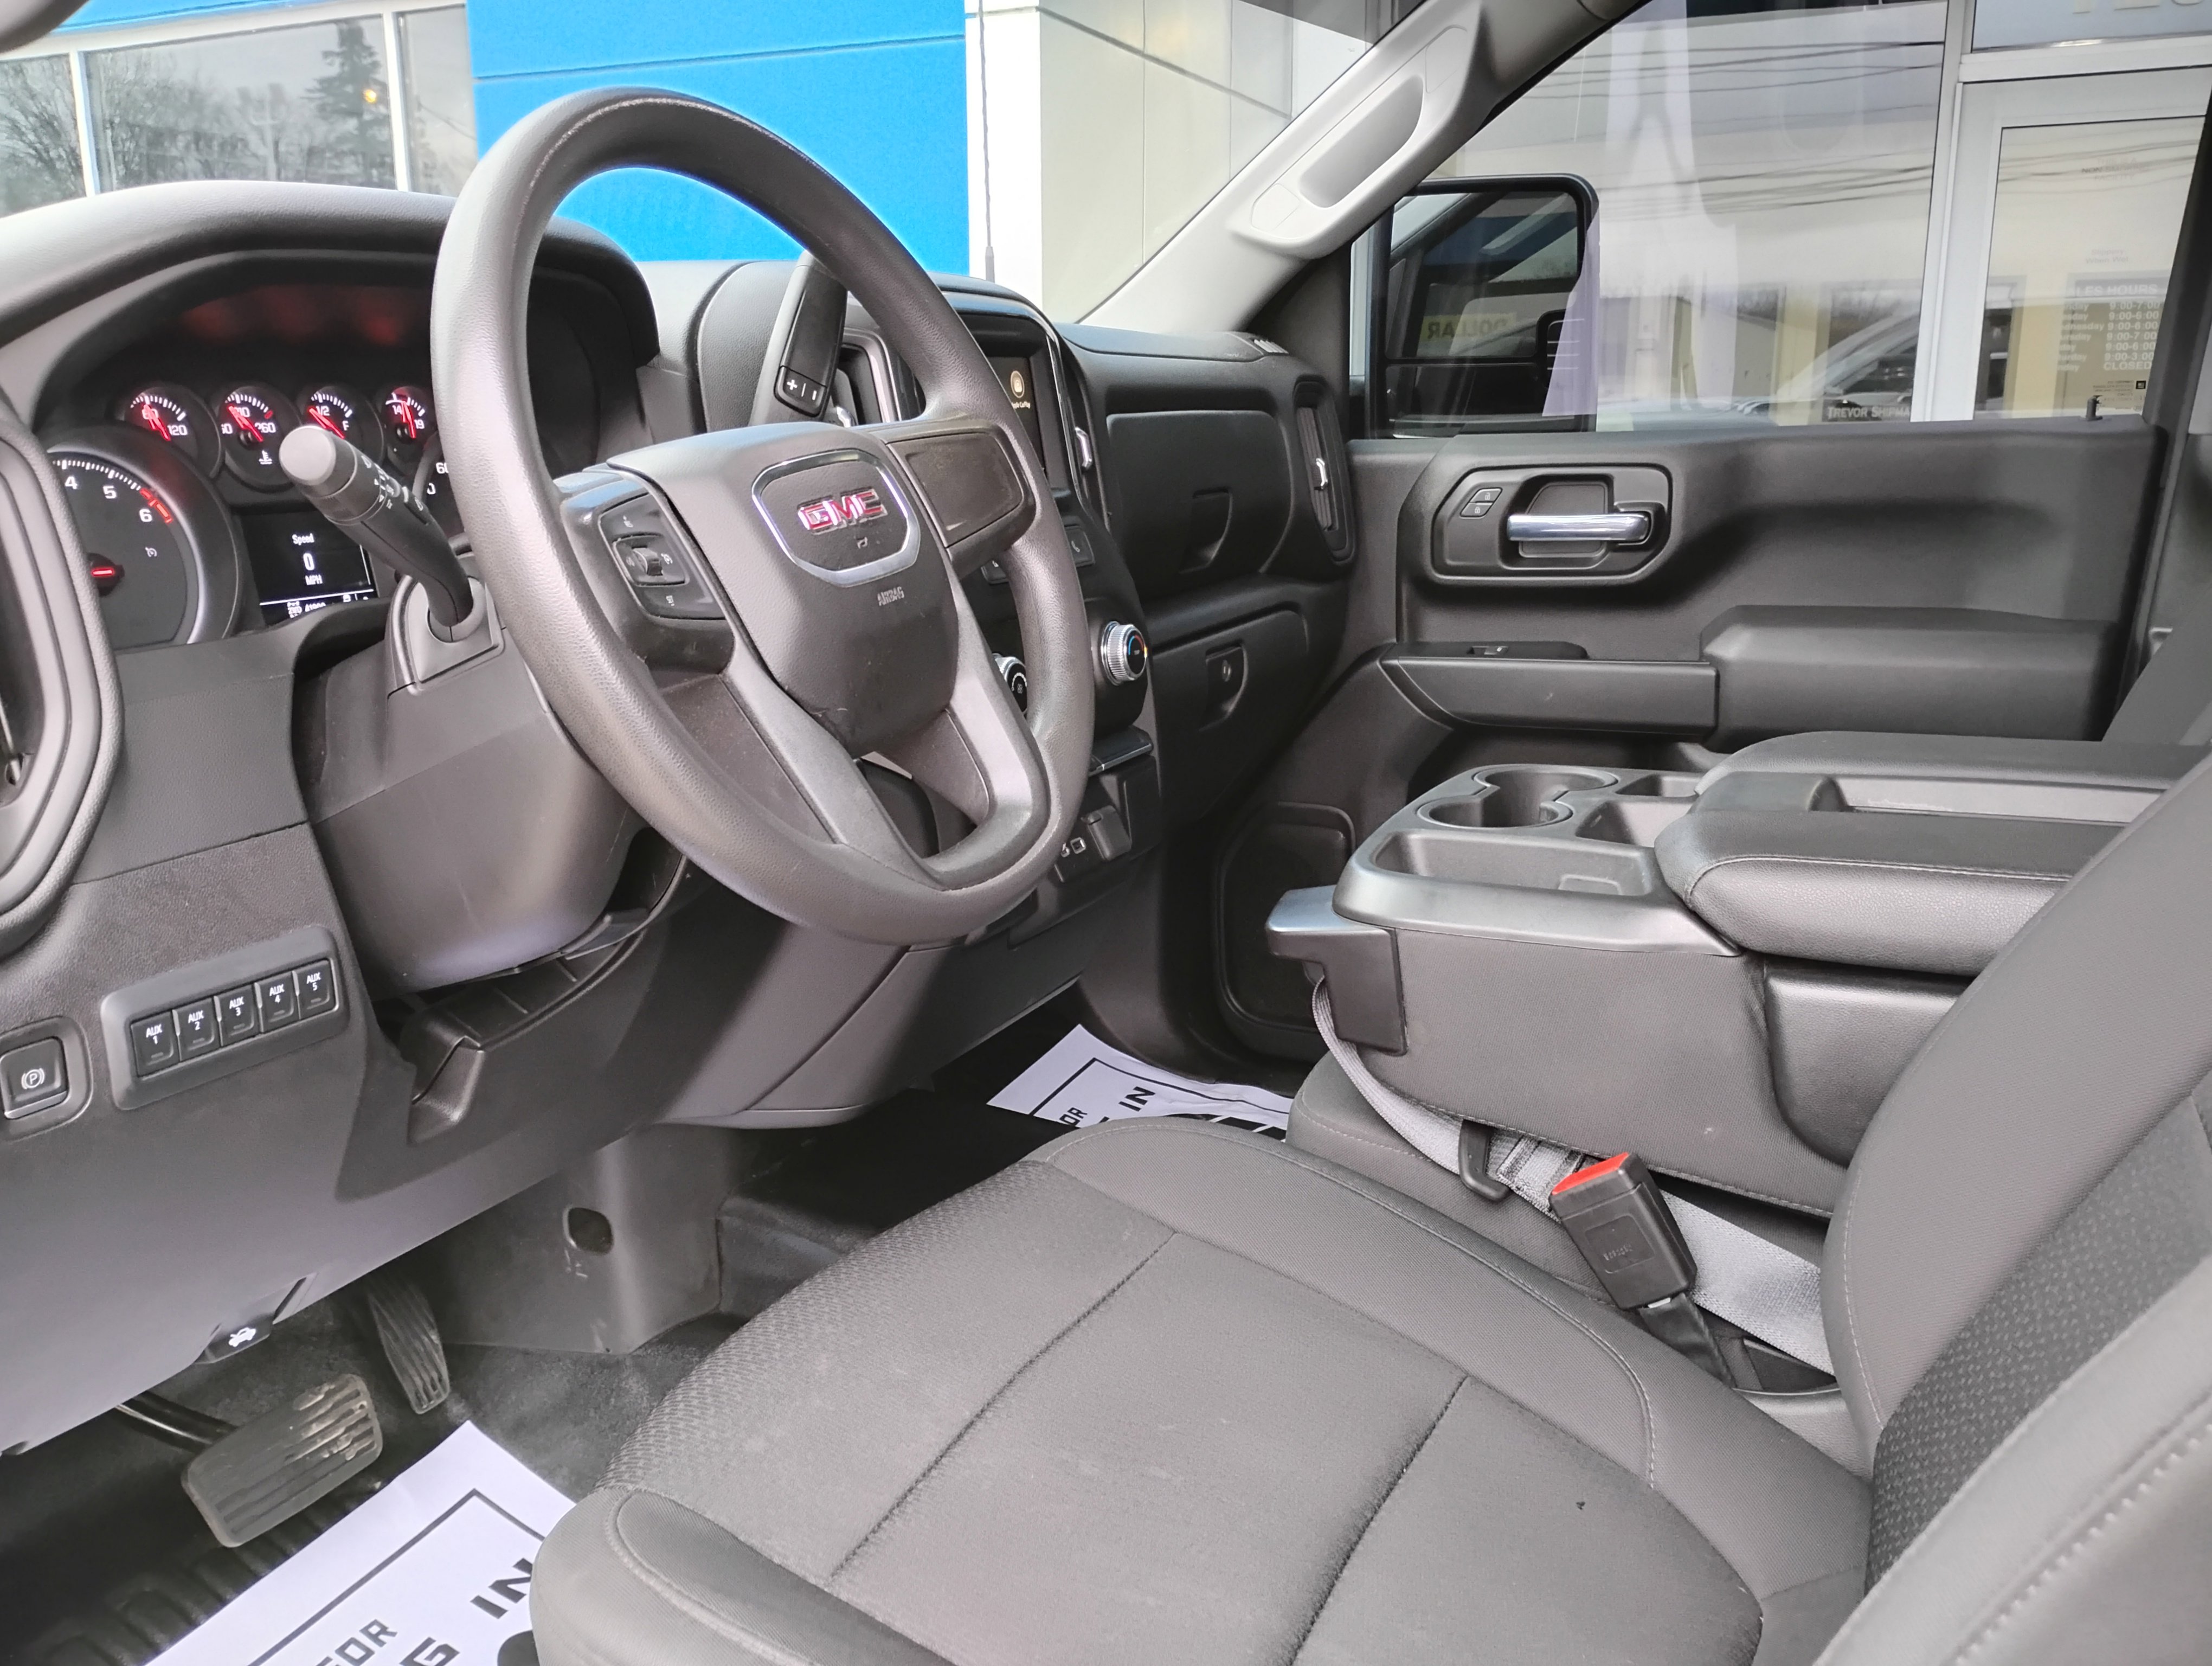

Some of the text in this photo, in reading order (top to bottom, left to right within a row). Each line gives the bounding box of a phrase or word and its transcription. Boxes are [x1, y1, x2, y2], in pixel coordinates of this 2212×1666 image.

[2106, 284, 2158, 295] HOURS
[2103, 361, 2152, 371] CLOSED
[1828, 406, 1910, 418] TREVOR SHIPMA
[168, 425, 188, 436] 120
[65, 476, 78, 490] 4
[102, 485, 117, 499] 5
[139, 508, 153, 522] 6
[798, 489, 888, 535] GMC
[292, 533, 314, 546] Speed
[303, 552, 315, 571] 0
[305, 574, 324, 586] MPH
[877, 586, 905, 606] AIRBAG
[306, 972, 321, 984] AUX
[269, 984, 285, 997] AUX
[312, 982, 318, 991] 5
[229, 996, 245, 1009] AUX
[274, 995, 281, 1003] 4
[188, 1010, 204, 1023] AUX
[236, 1008, 242, 1016] 3
[146, 1024, 163, 1038] AUX
[195, 1022, 201, 1030] 2
[152, 1036, 158, 1045] 1
[1118, 1086, 1156, 1112] IN
[470, 1558, 533, 1619] IN
